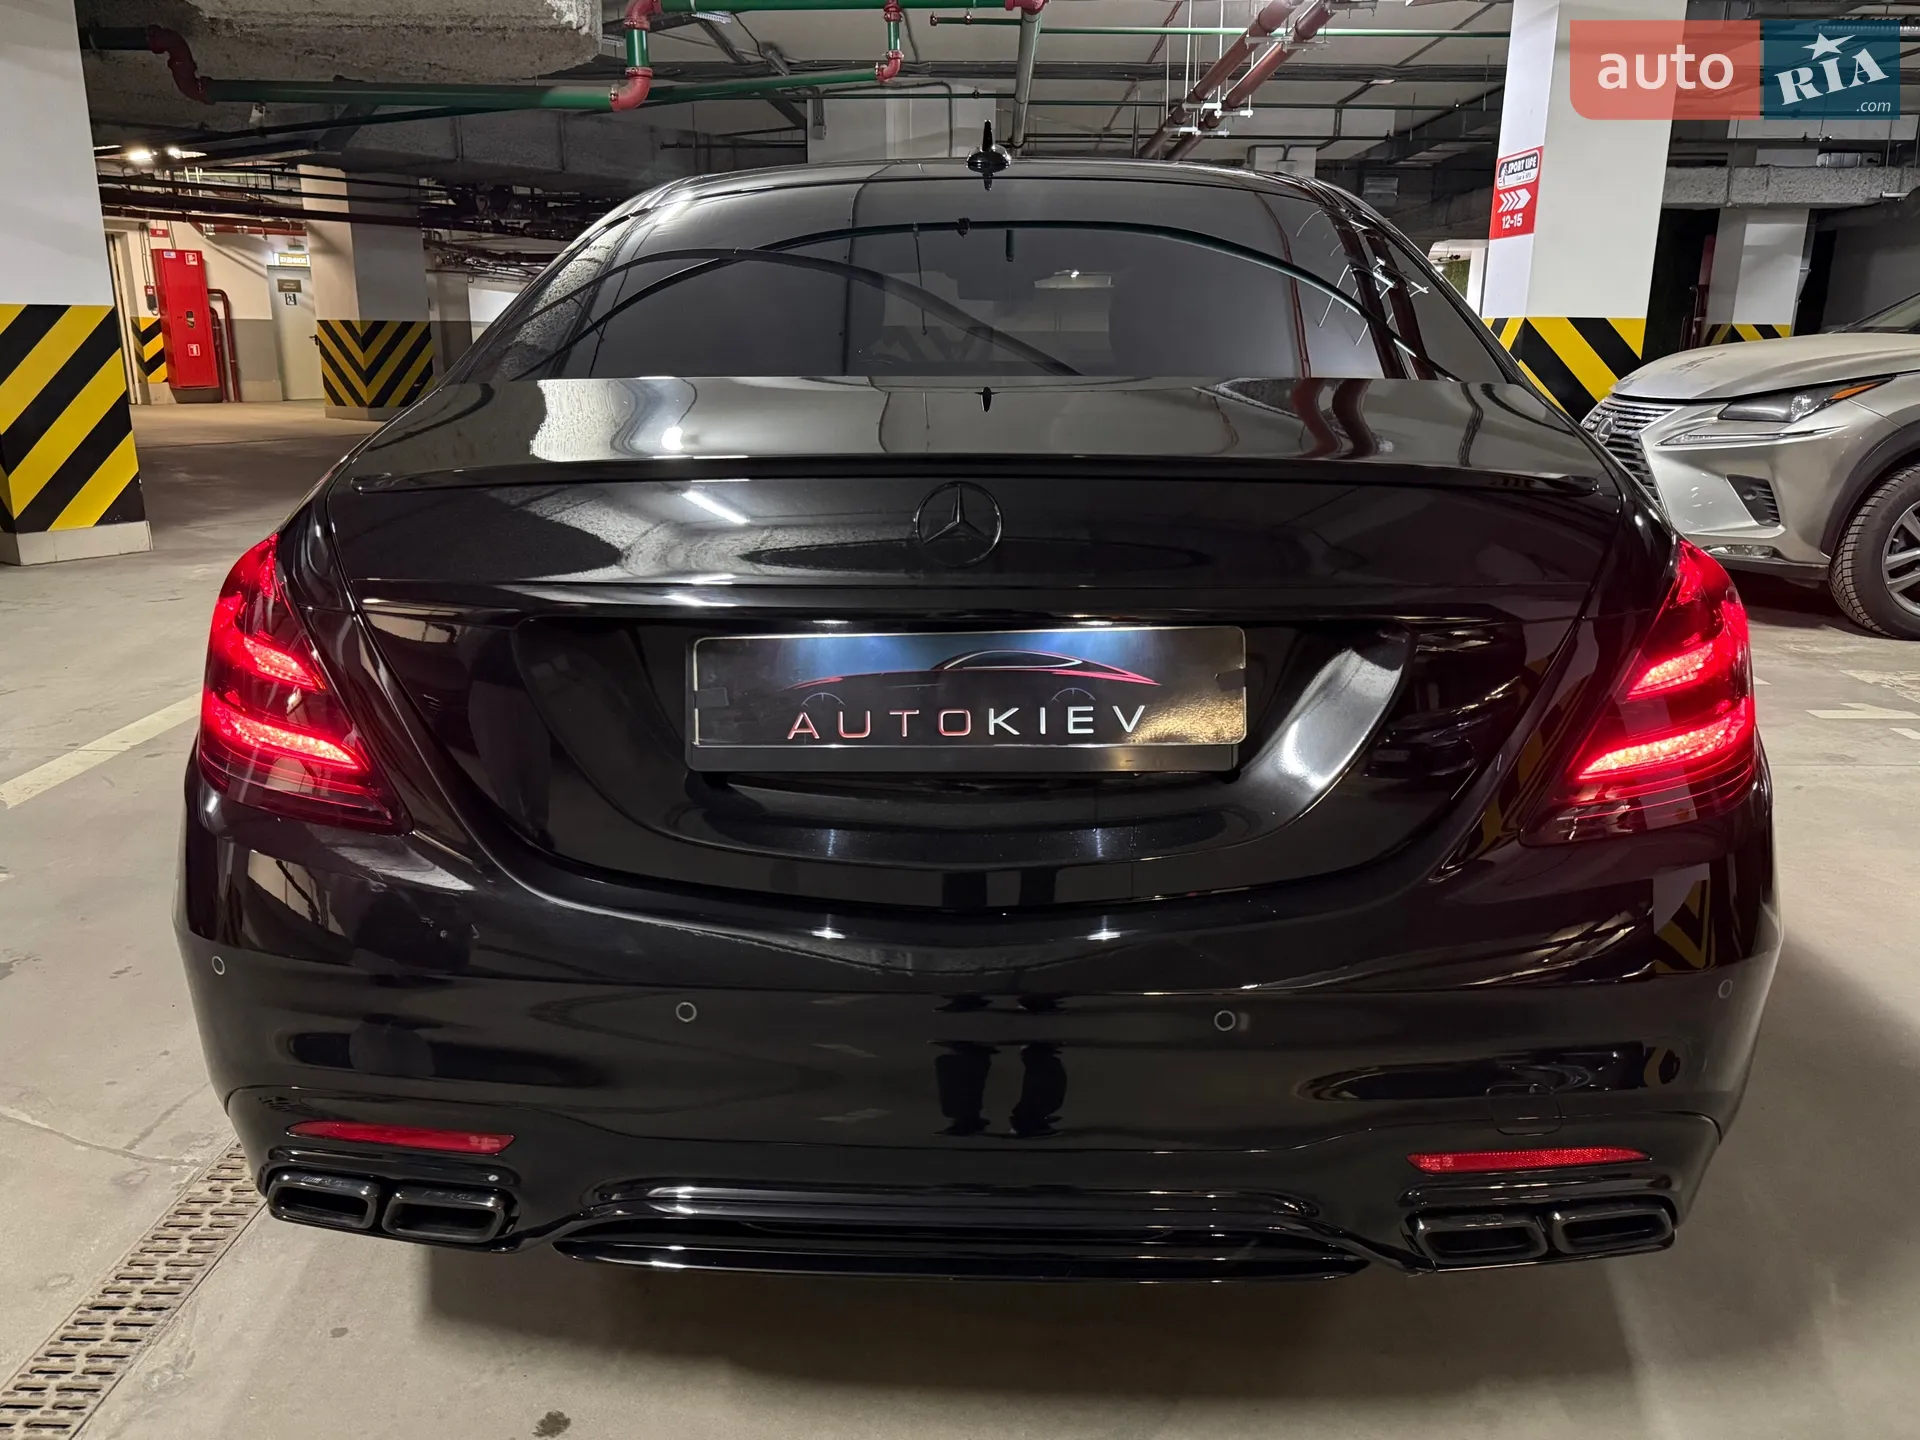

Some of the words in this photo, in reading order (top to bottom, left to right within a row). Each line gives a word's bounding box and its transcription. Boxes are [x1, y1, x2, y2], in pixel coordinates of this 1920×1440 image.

[1508, 160, 1524, 173] SPORT
[1502, 213, 1523, 229] 12-15
[787, 704, 1147, 740] AUTOKIEV
